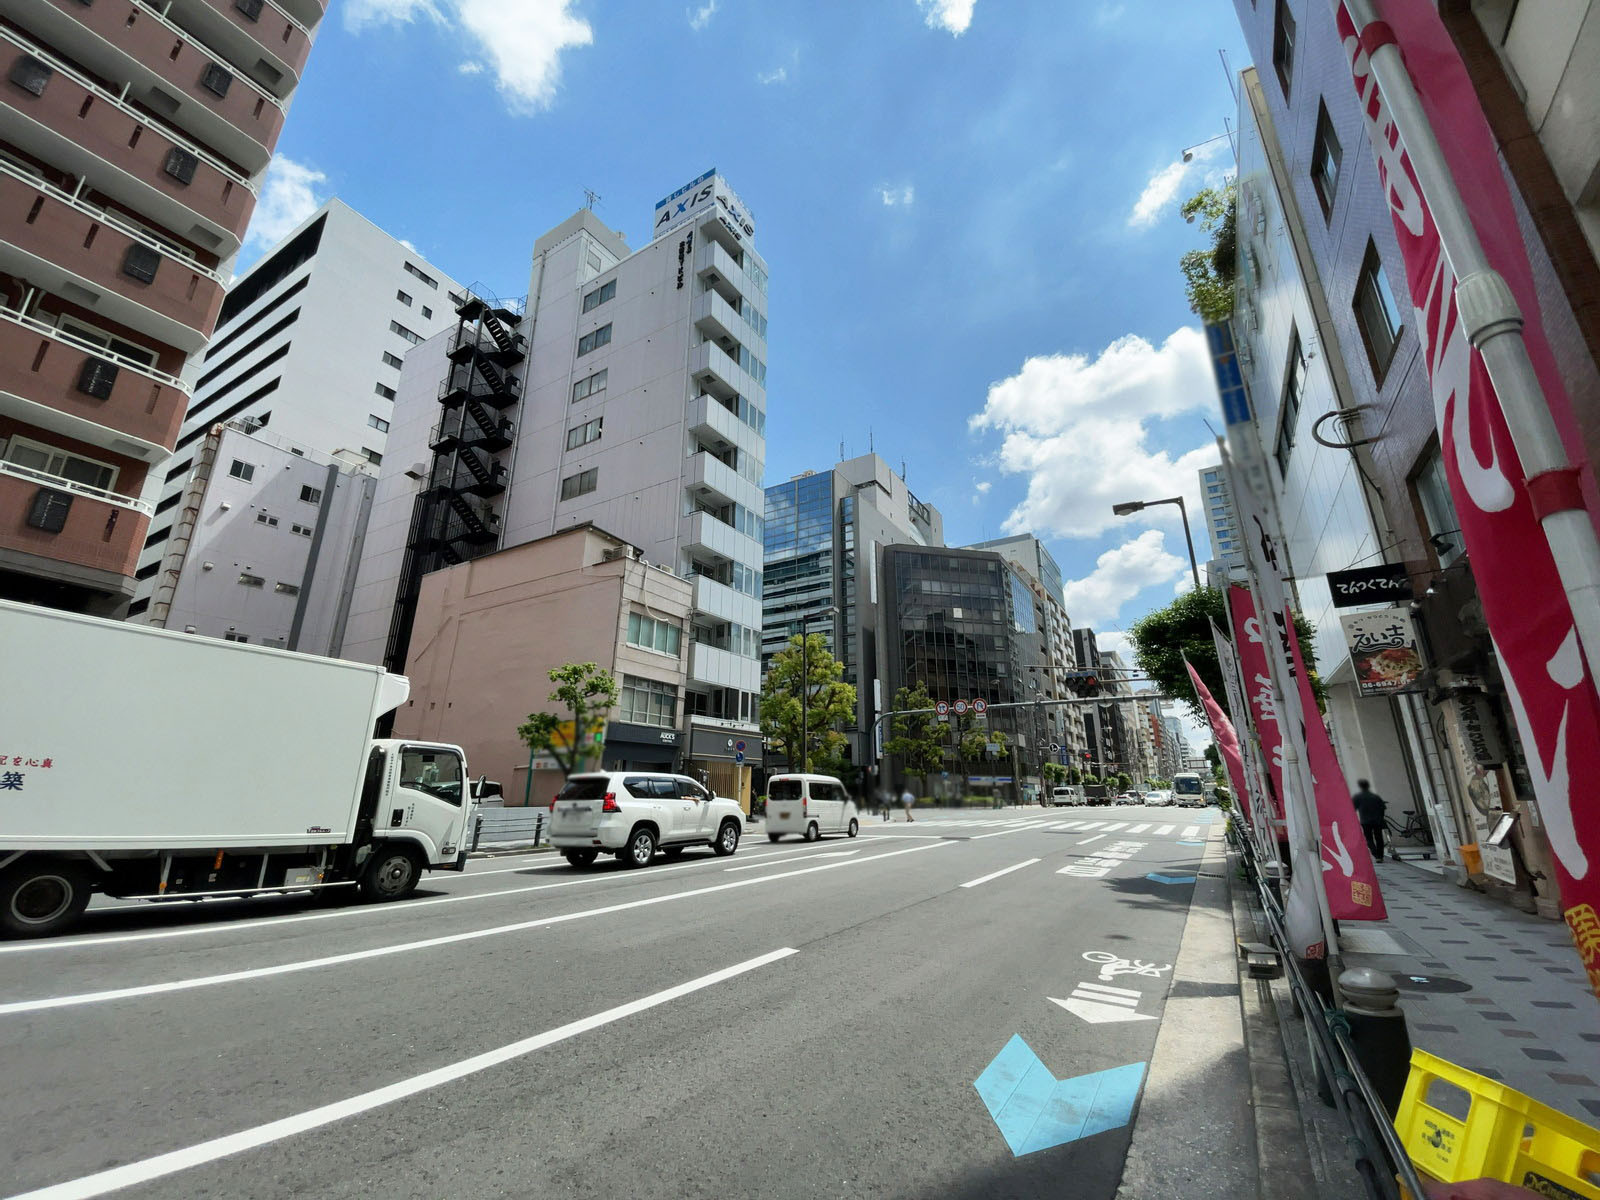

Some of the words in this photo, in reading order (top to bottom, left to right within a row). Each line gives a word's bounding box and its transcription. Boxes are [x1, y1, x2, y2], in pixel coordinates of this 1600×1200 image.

[656, 184, 713, 228] AXIS
[716, 195, 754, 237] AXIS
[719, 216, 743, 241] AXIS
[1336, 579, 1399, 594] てんつくてん
[1352, 624, 1405, 653] えい吉
